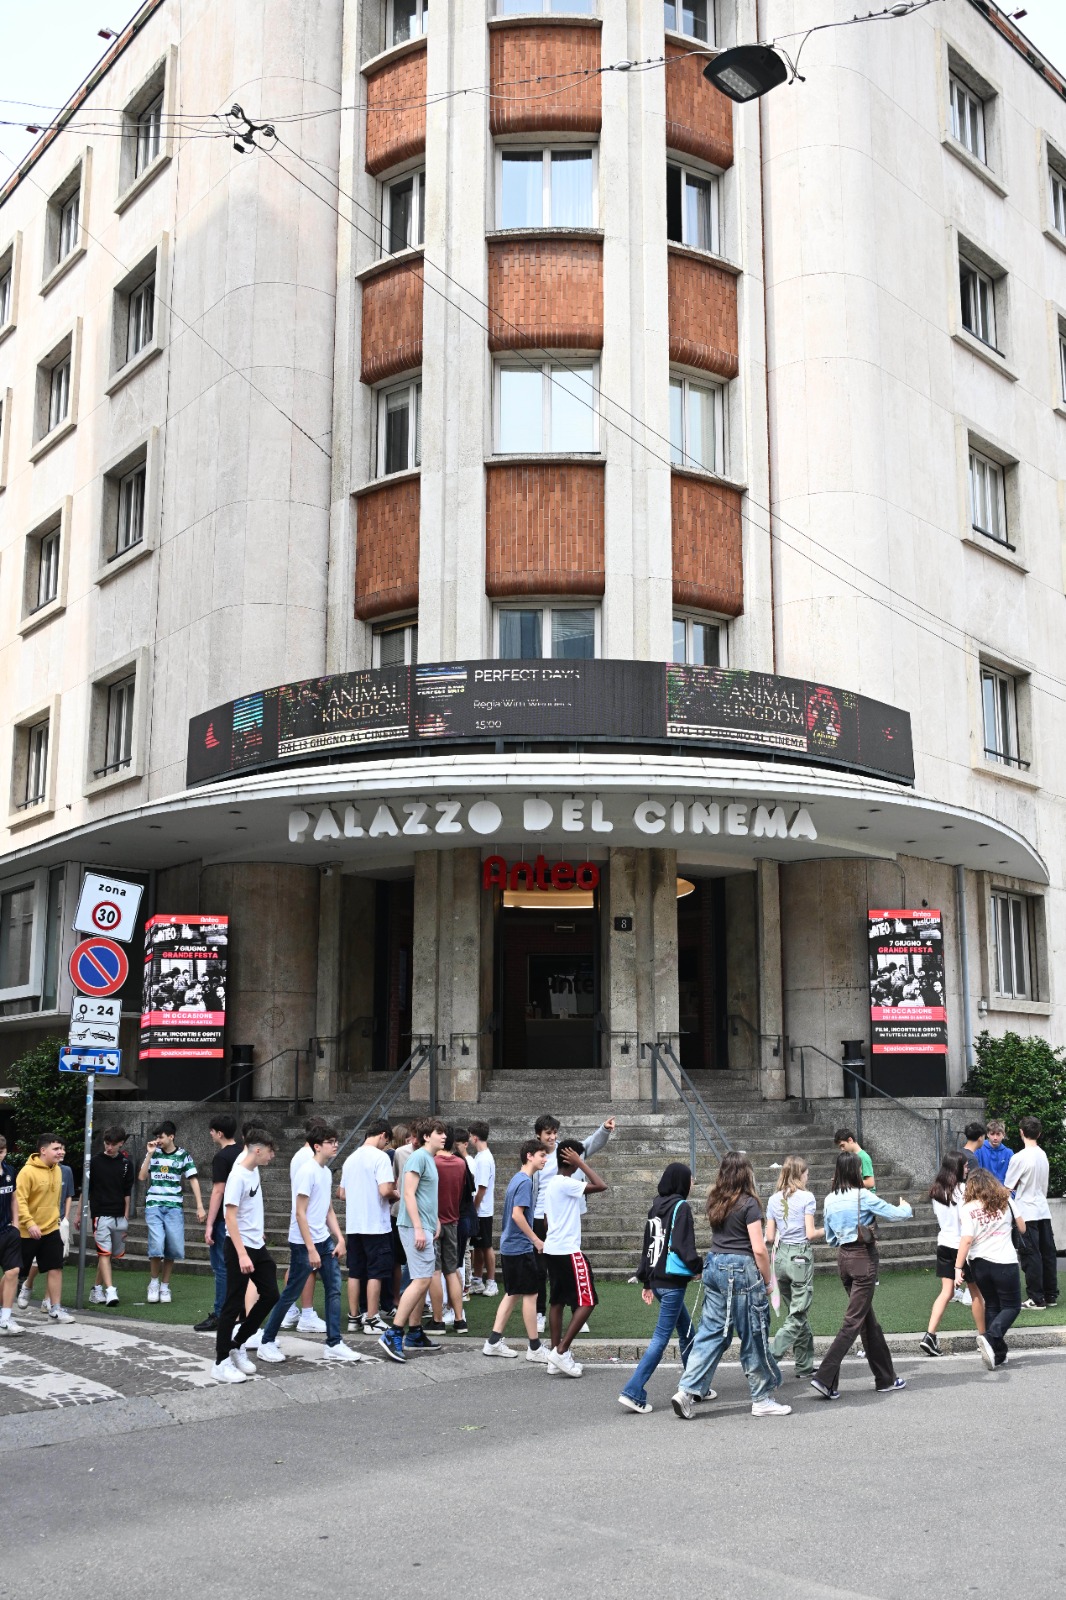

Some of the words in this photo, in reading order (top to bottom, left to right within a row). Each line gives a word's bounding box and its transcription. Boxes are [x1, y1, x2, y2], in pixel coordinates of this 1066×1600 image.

[474, 669, 540, 682] PERFECT
[542, 668, 580, 682] DAYS
[328, 682, 400, 707] ANIMAL
[729, 685, 800, 710] ANIMAL
[322, 700, 407, 723] KINGDOM
[723, 703, 804, 725] KINGDOM
[310, 734, 347, 748] GIUGNO
[349, 733, 360, 742] AL
[768, 735, 804, 748] CINEMA
[288, 799, 503, 843] PALAZZO
[523, 798, 614, 833] DEL
[633, 800, 818, 841] CINEMA
[482, 855, 600, 891] Anteo
[98, 883, 127, 897] zona
[97, 908, 116, 924] 30
[621, 919, 628, 929] 8
[79, 1004, 88, 1014] 0
[97, 1005, 114, 1016] 24
